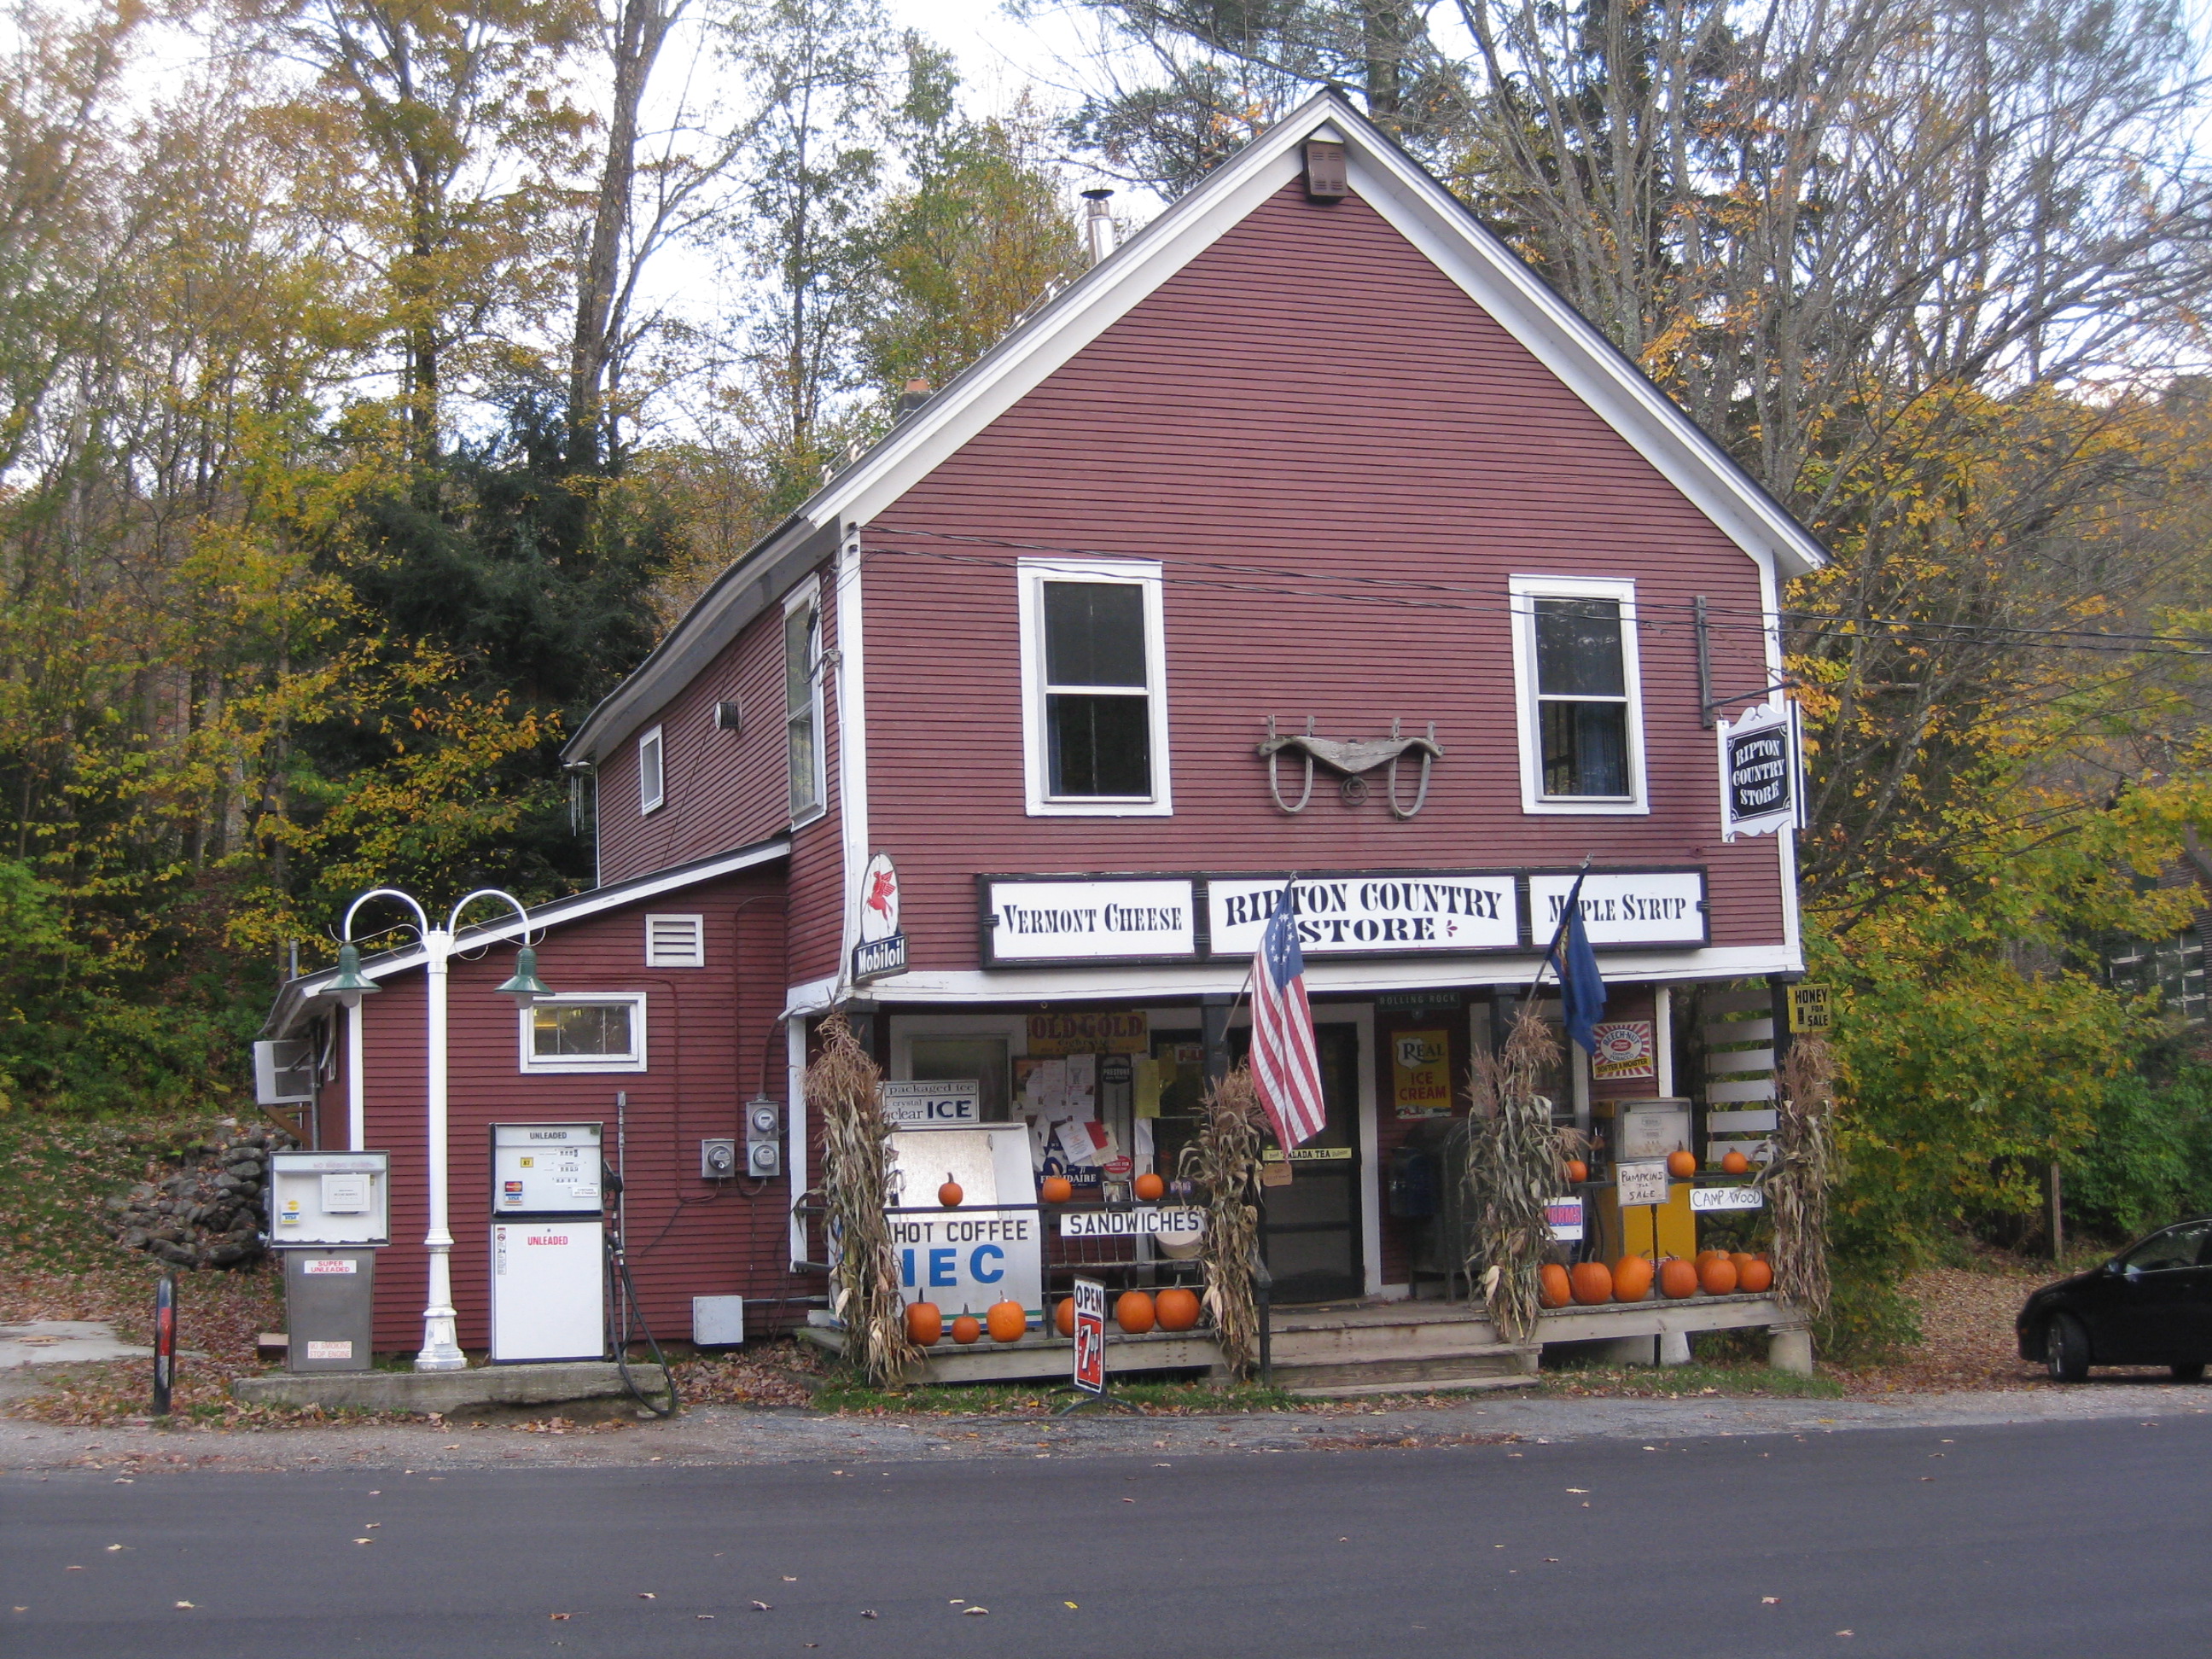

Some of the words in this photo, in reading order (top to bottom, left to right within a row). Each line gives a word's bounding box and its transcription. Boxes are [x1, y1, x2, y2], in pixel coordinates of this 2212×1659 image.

[1736, 739, 1780, 768] RIPTON
[1732, 759, 1784, 787] COUNTRY
[1739, 779, 1780, 806] STORE
[1359, 882, 1503, 921] COUNTRY
[1548, 895, 1616, 923] MPLE
[1622, 894, 1686, 921] SYRUP
[1002, 905, 1097, 934] VERMONT
[1104, 903, 1183, 933] CHEESE
[1296, 917, 1435, 944] STORE
[858, 939, 905, 975] Mobiloil
[1379, 995, 1424, 1005] ROLLING
[1429, 993, 1458, 1003] ROCK
[1795, 988, 1827, 1004] HONEY
[1031, 1016, 1077, 1039] OLD
[1078, 1015, 1143, 1038] GOLD
[1807, 1014, 1829, 1027] SALE
[889, 1084, 952, 1095] packaged
[1411, 1072, 1434, 1085] ICE
[1399, 1086, 1447, 1101] CREAM
[891, 1109, 923, 1120] clear
[927, 1100, 972, 1119] ICE
[1315, 1150, 1330, 1158] TEA
[1629, 1190, 1656, 1201] SALE
[1692, 1190, 1724, 1208] CAMP
[894, 1222, 934, 1243] HOT
[946, 1220, 1028, 1243] COFFEE
[1070, 1211, 1199, 1235] SANDWICHES
[527, 1236, 568, 1246] UNLEADED
[1075, 1284, 1103, 1314] OPEN
